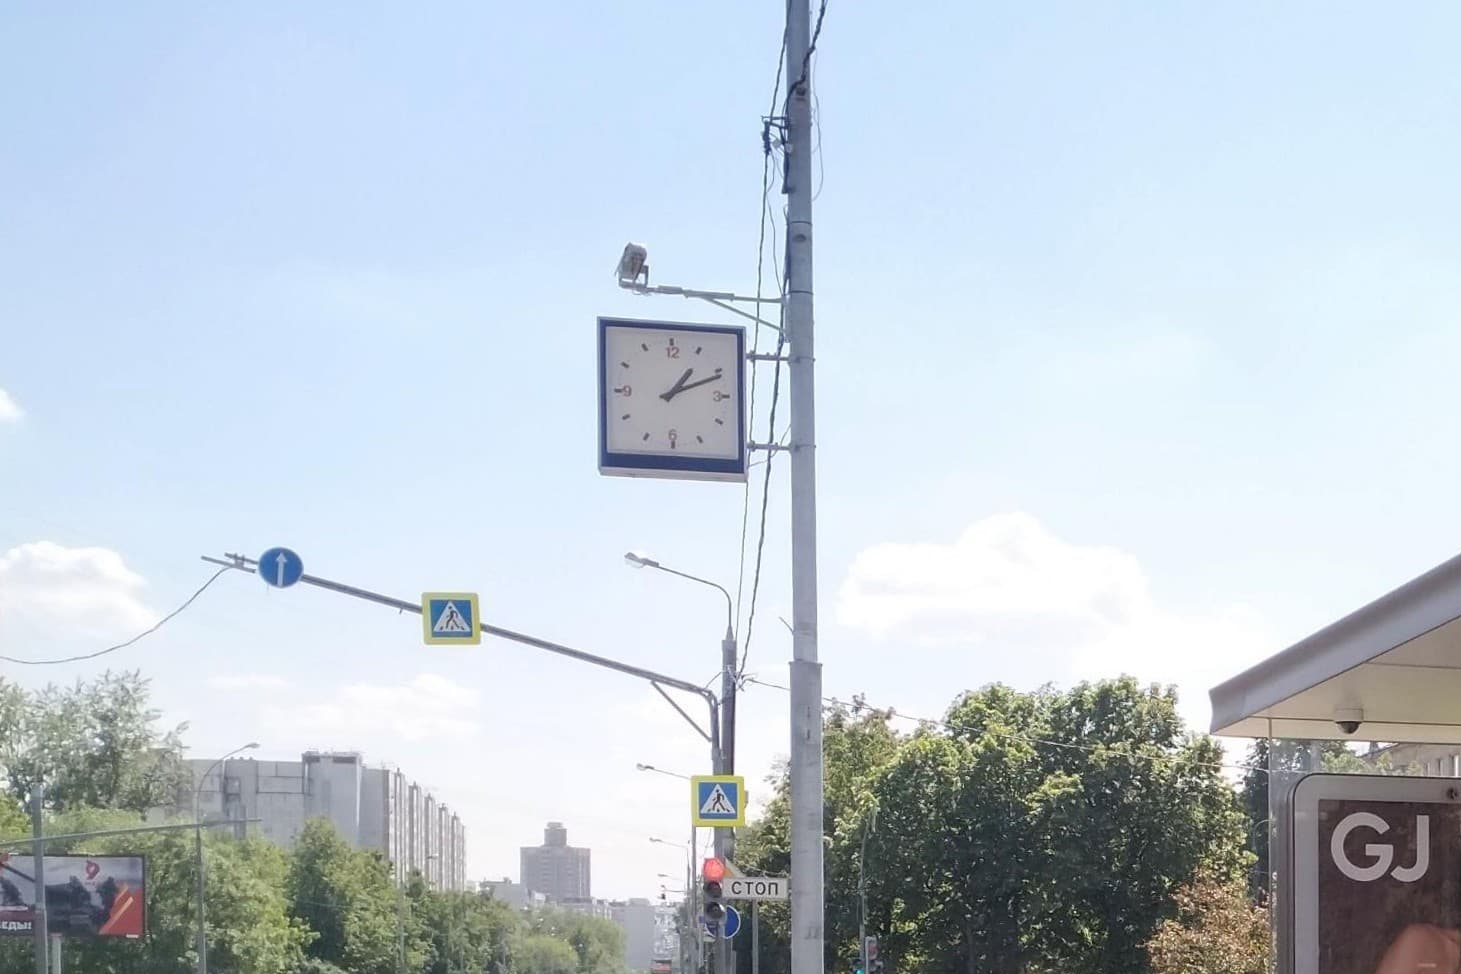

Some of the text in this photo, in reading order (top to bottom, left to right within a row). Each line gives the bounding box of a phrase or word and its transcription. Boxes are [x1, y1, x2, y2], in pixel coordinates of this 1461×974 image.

[666, 347, 680, 359] 12
[623, 386, 632, 397] 9
[713, 391, 722, 401] 3
[668, 430, 677, 441] 6
[1331, 811, 1430, 883] GJ
[731, 881, 779, 896] СТОП
